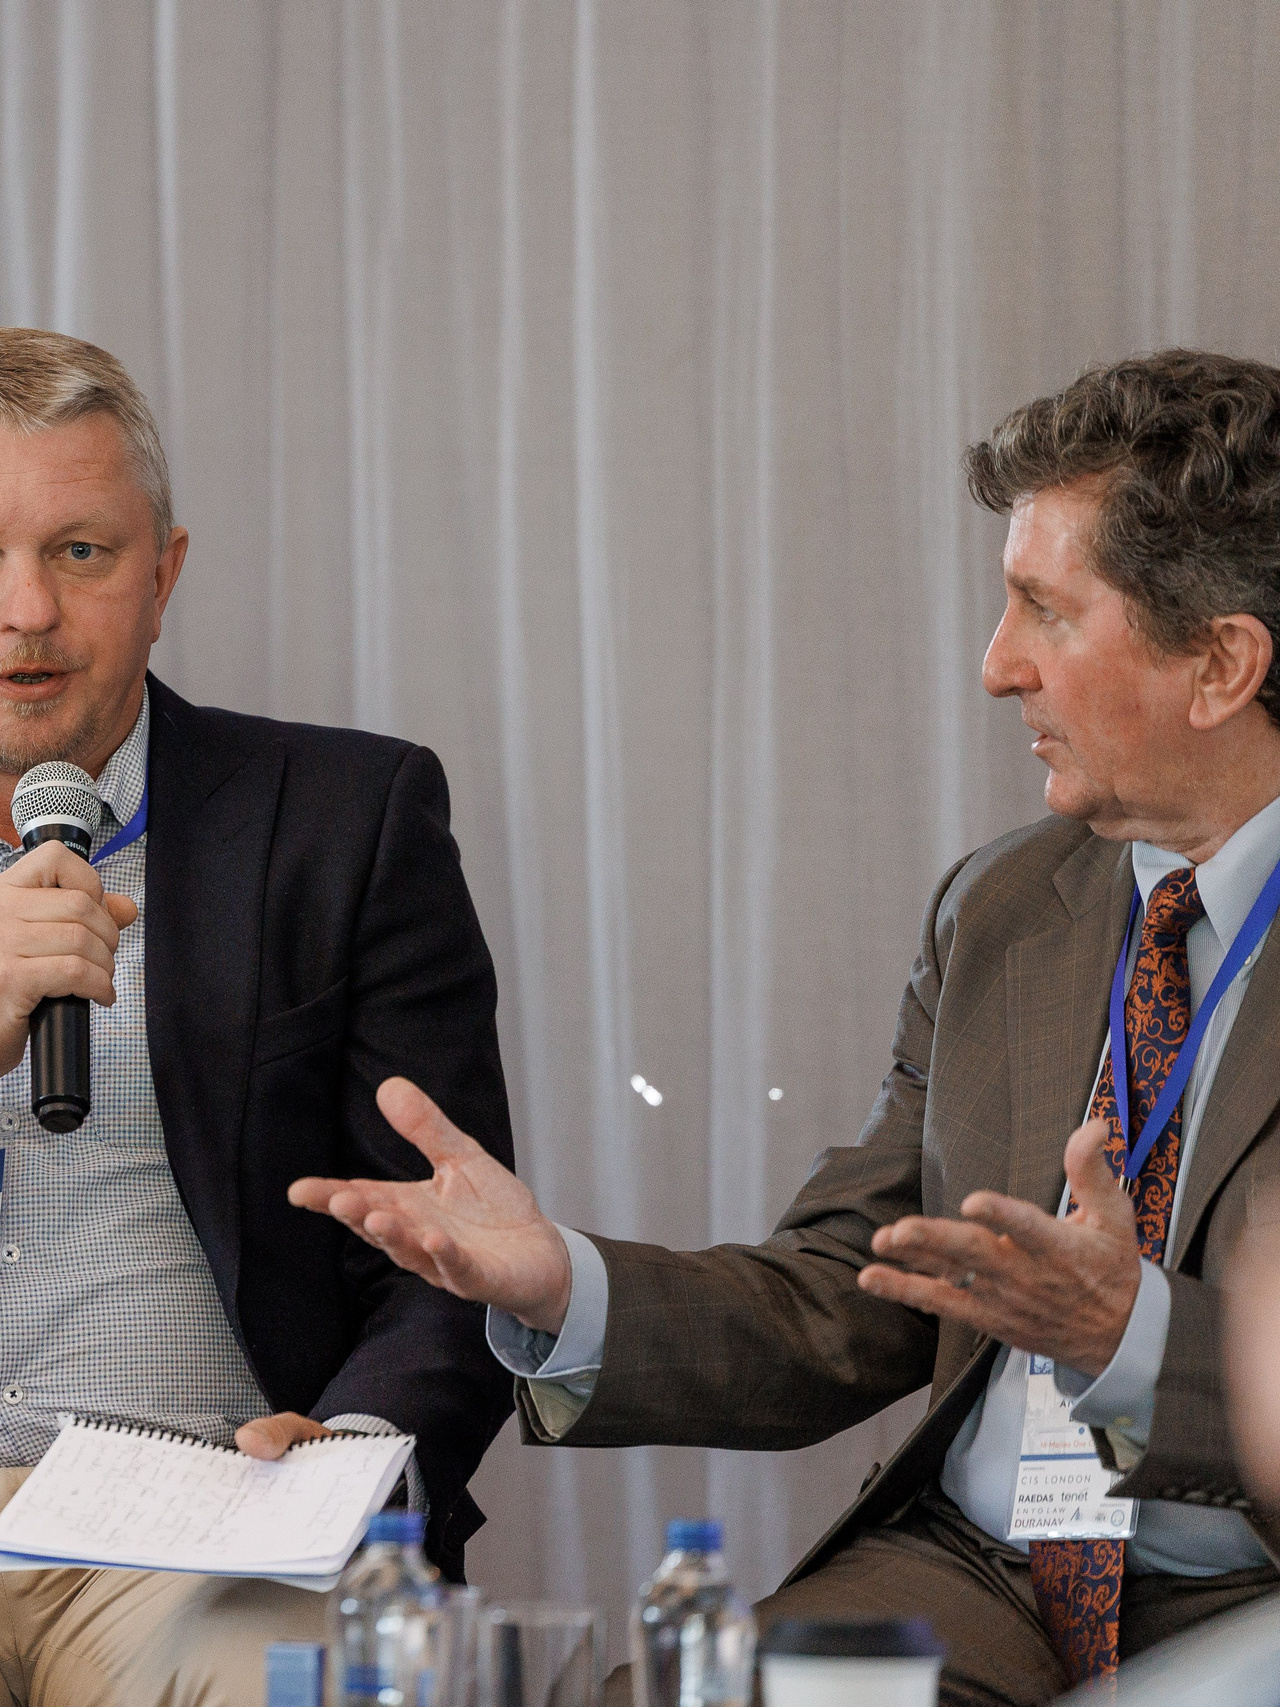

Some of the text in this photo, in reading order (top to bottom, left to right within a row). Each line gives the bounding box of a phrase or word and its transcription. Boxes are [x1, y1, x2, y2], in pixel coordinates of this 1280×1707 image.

[1021, 1474, 1091, 1485] CIS LONDON
[1018, 1493, 1054, 1503] RAEDAS
[1014, 1517, 1065, 1529] DURANAY
